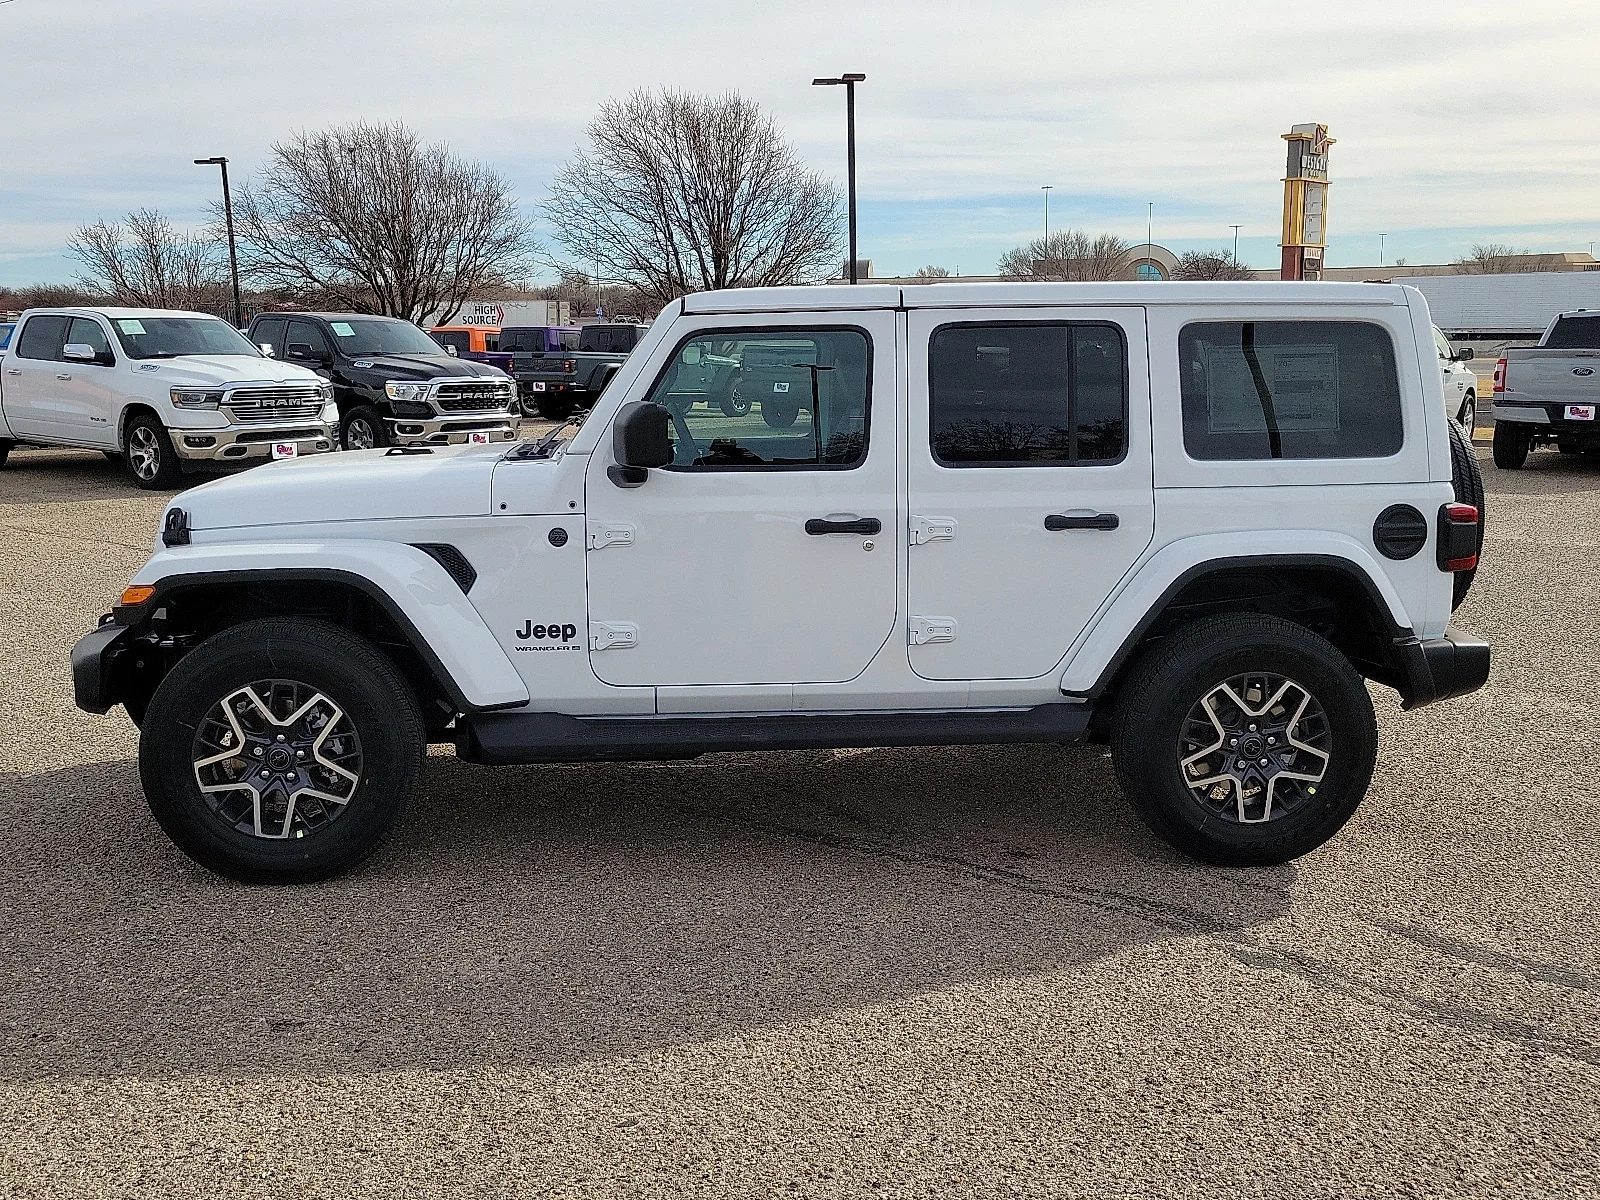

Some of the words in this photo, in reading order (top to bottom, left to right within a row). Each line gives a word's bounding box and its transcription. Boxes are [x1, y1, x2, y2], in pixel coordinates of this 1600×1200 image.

[474, 305, 496, 315] HIGH
[462, 315, 497, 325] SOURCE
[262, 398, 301, 407] RAM
[515, 619, 577, 643] Jeep
